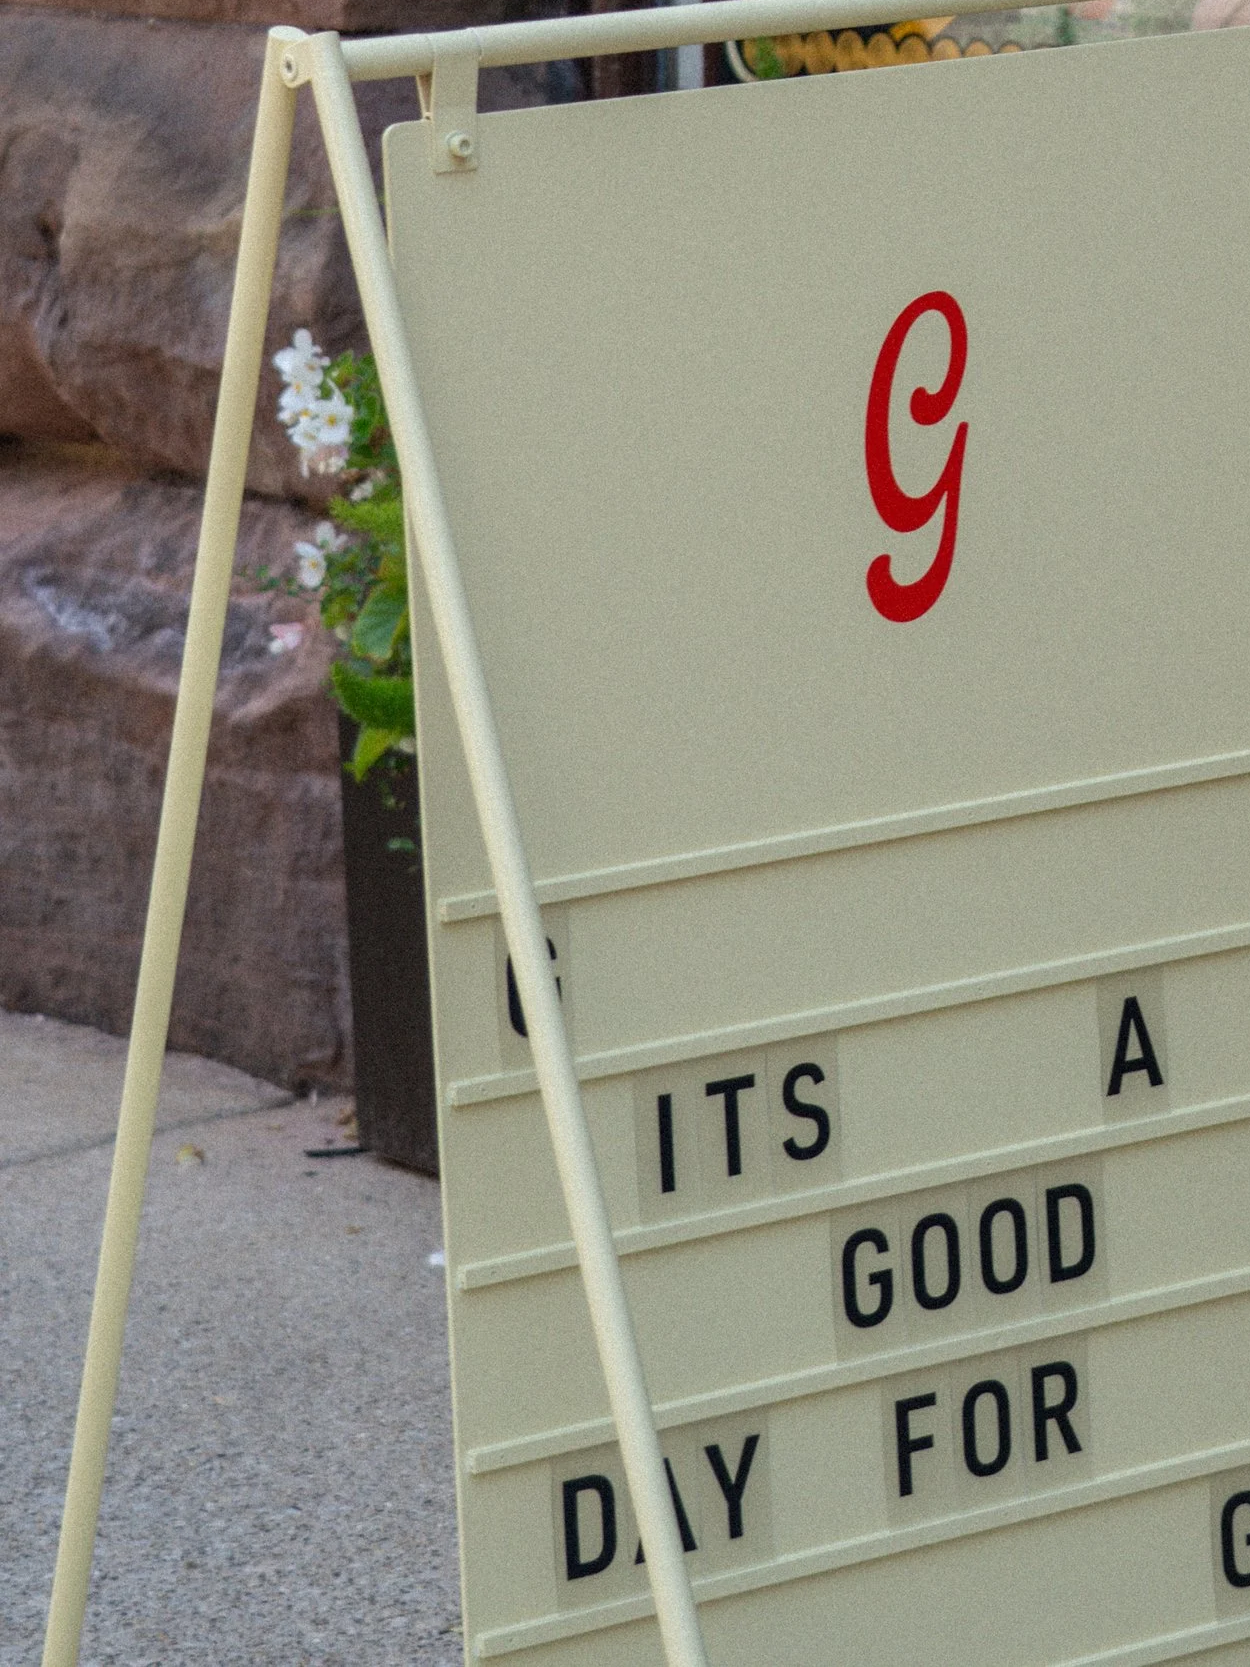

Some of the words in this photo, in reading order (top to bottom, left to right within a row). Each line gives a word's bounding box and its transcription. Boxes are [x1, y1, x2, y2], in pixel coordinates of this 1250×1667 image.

[657, 1061, 832, 1195] ITS
[1105, 995, 1164, 1097] A
[839, 1182, 1098, 1329] GOOD
[895, 1360, 1083, 1498] FOR
